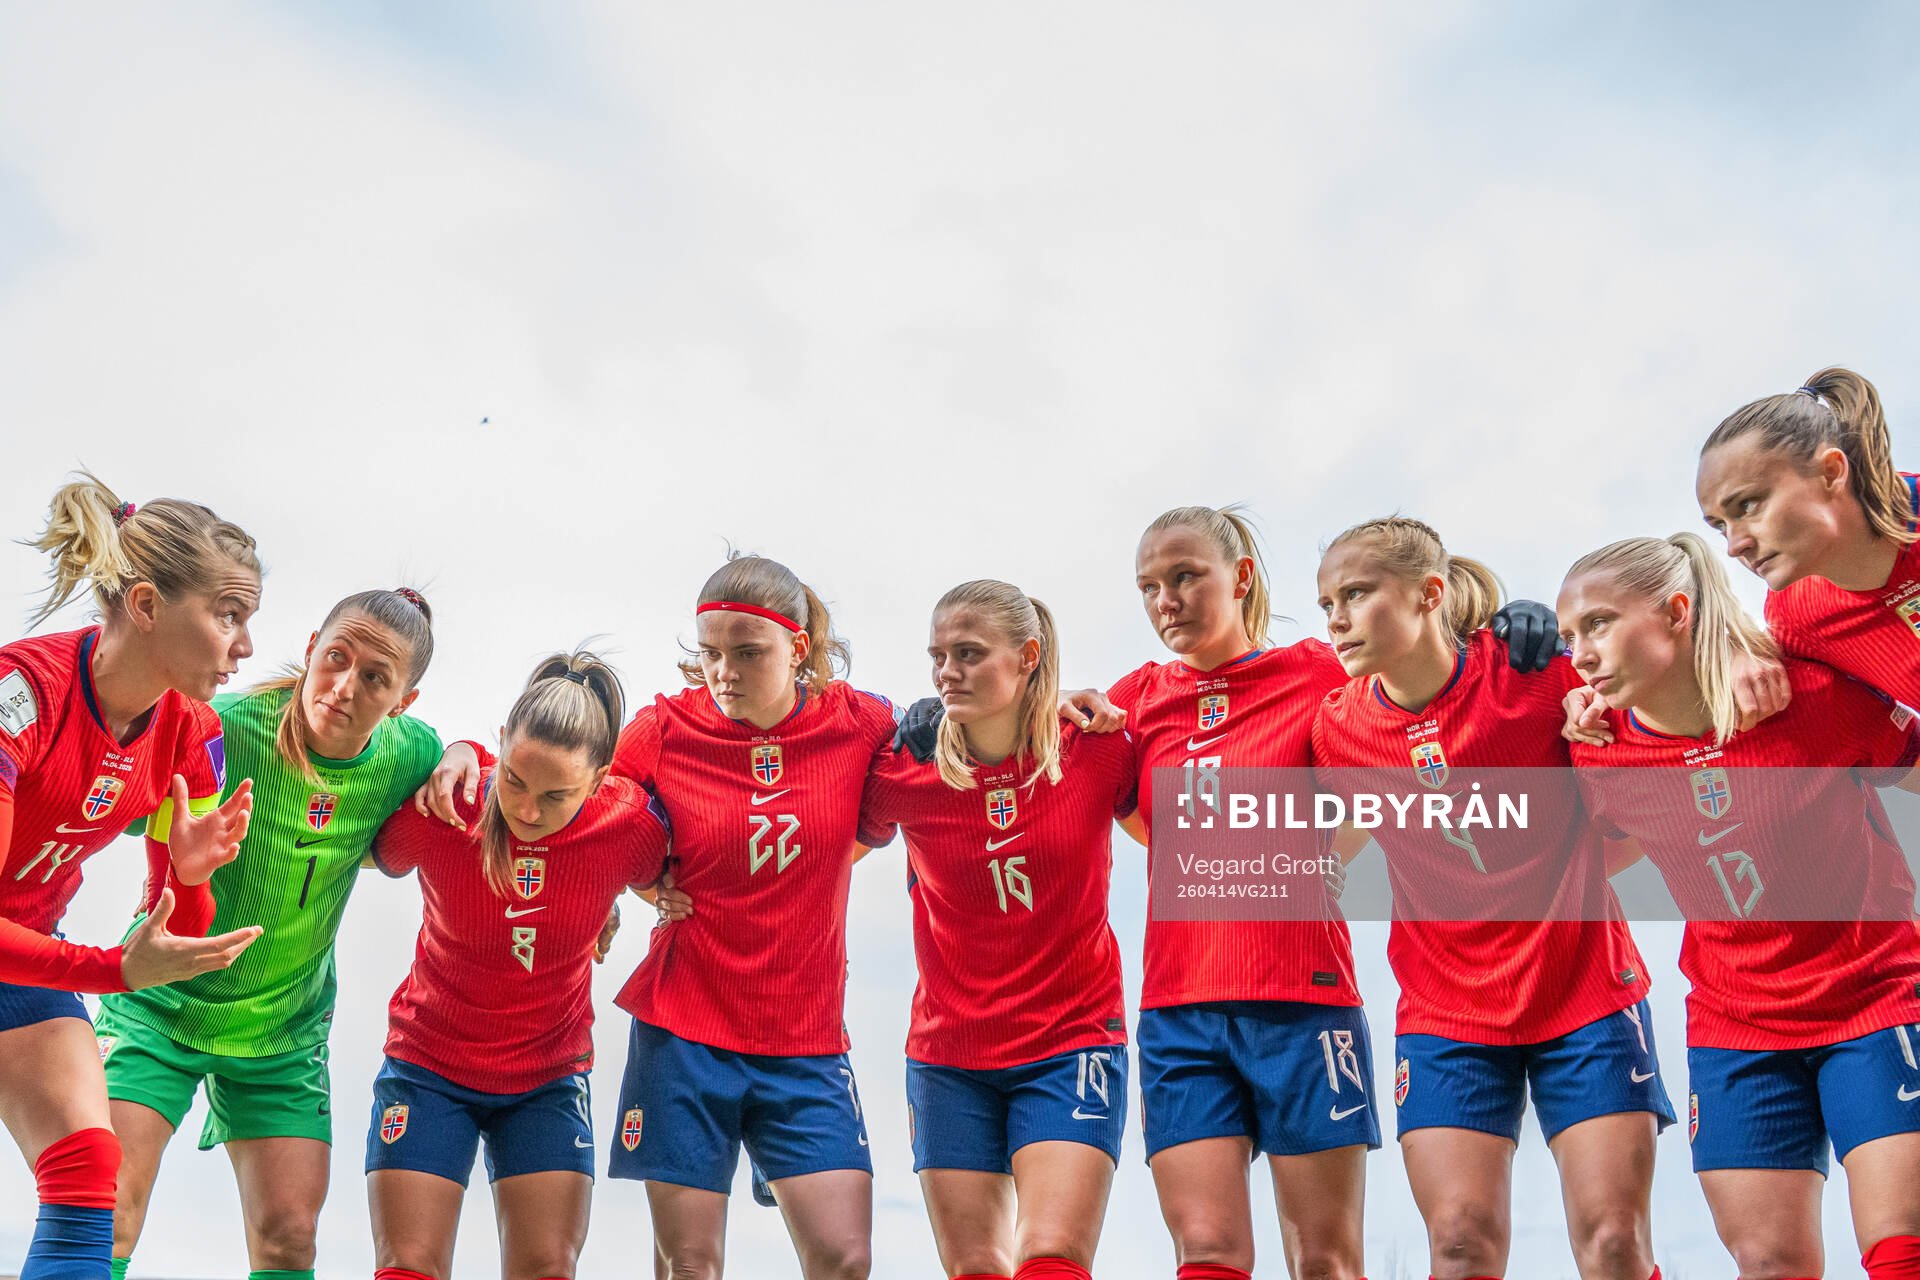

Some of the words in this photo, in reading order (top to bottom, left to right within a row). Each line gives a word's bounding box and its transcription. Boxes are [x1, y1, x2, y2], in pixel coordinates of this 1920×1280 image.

[1683, 748, 1699, 758] NOR
[1685, 751, 1723, 766] 14.04.2026
[14, 840, 84, 884] 14
[748, 814, 801, 876] 22
[299, 856, 318, 910] 1
[987, 855, 1033, 914] 16
[1706, 850, 1764, 919] 13
[512, 926, 537, 975] 8
[1076, 1052, 1111, 1108] 16
[1317, 1030, 1364, 1094] 18
